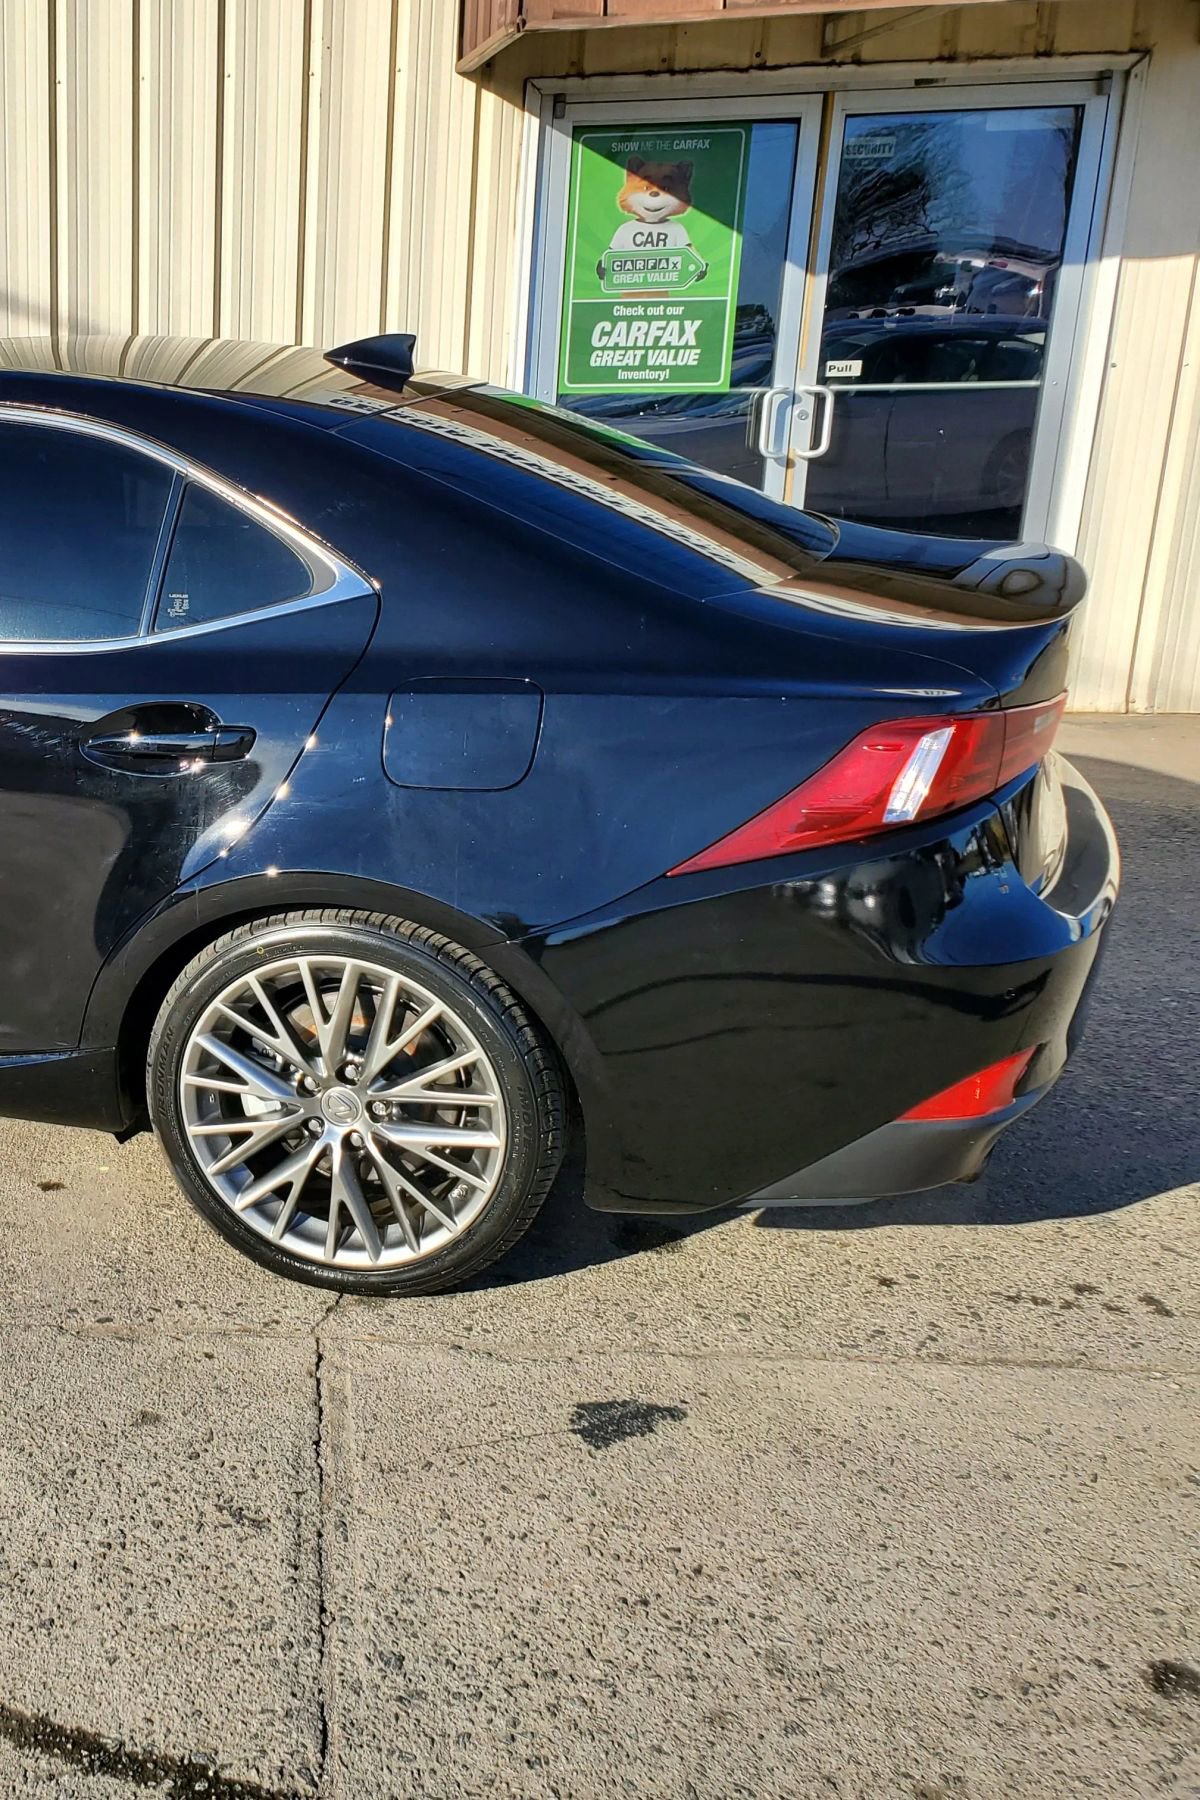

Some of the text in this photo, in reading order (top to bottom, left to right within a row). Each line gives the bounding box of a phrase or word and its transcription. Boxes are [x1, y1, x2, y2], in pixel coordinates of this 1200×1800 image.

[611, 139, 711, 152] SHOW ME THE CARFAX
[632, 232, 668, 247] CAR
[612, 257, 680, 272] CARFAX
[613, 272, 679, 284] GREAT VALUE
[613, 305, 685, 316] Check out our
[591, 320, 703, 347] CARFAX
[590, 349, 701, 367] GREAT VALUE
[618, 369, 670, 381] Inventory!
[828, 364, 852, 373] Pull
[157, 1026, 175, 1120] IRONMAN
